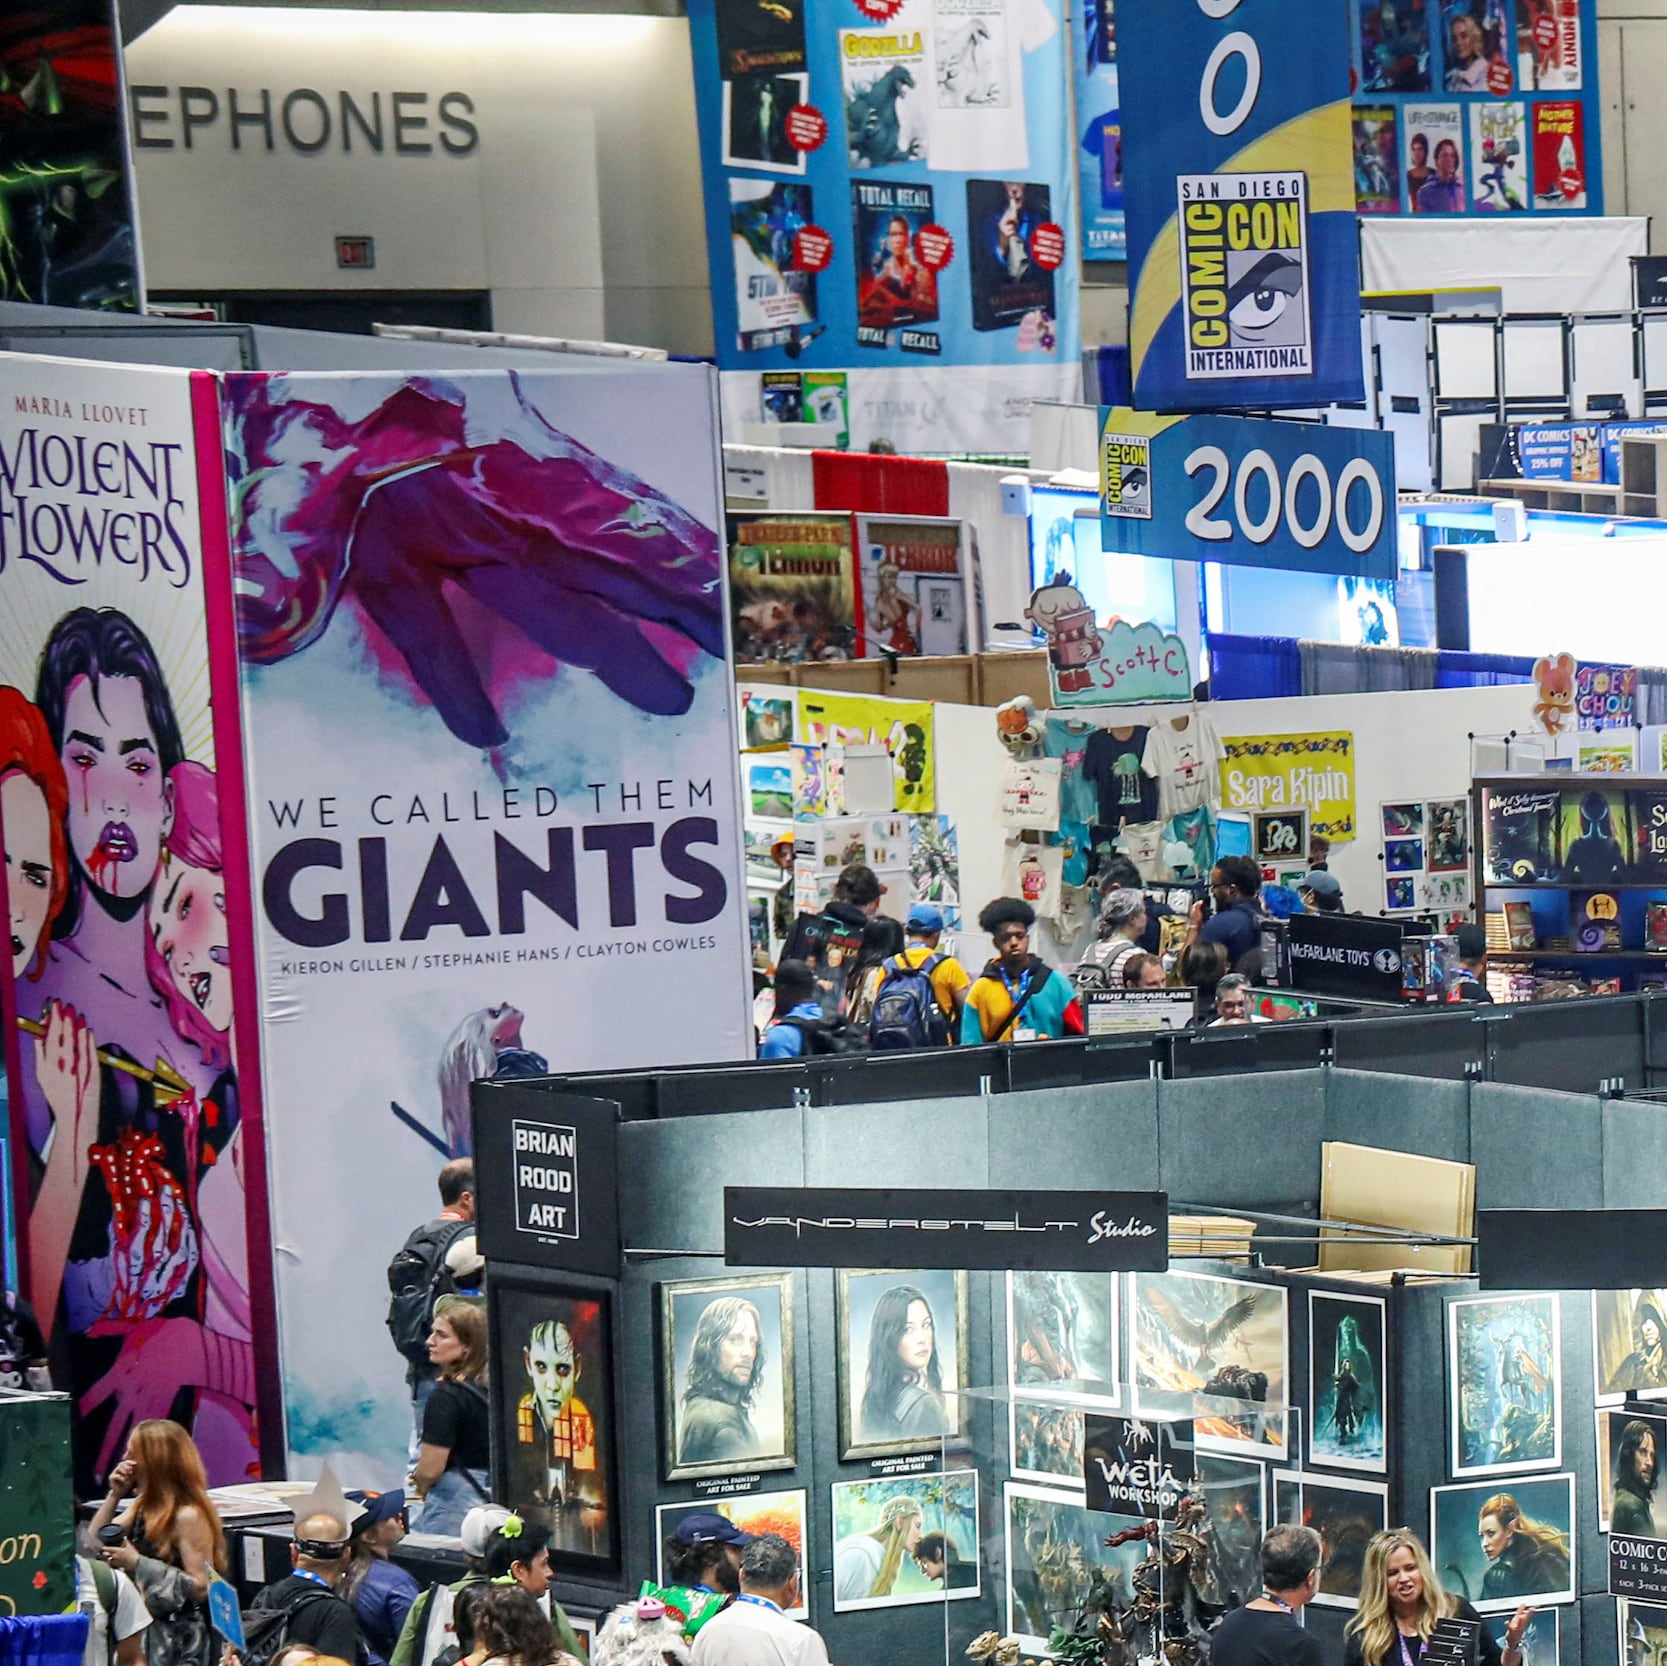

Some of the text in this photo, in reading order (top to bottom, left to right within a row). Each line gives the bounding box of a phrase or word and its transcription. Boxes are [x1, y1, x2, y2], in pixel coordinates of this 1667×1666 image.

[843, 31, 924, 58] GODZILLA
[859, 185, 931, 208] TOTAL RECALL
[1182, 179, 1300, 199] SAN DIEGO
[1226, 202, 1300, 250] CON
[1186, 203, 1229, 348] COMIC
[1190, 347, 1308, 372] INTERNATIONAL
[14, 395, 149, 426] MARIA LLOVET
[0, 428, 182, 502] VIOLENT
[1121, 445, 1147, 465] CON
[1183, 445, 1383, 552] 2000
[1102, 646, 1159, 688] Scott
[1579, 668, 1635, 697] JOEY
[1580, 694, 1634, 716] CHOU
[268, 778, 714, 828] WE CALLED THEM
[1228, 766, 1349, 813] Sara Kipin
[262, 816, 727, 948] GIANTS
[281, 935, 716, 975] KIERON GILLEN STEPHANIE HANS CLAYTON COWLES
[515, 1128, 575, 1157] BRIAN
[519, 1165, 572, 1193] ROOD
[528, 1204, 567, 1228] ART
[1088, 1211, 1156, 1244] Studio
[1109, 1485, 1178, 1508] WORKSHOP
[1610, 1540, 1654, 1560] COMIC
